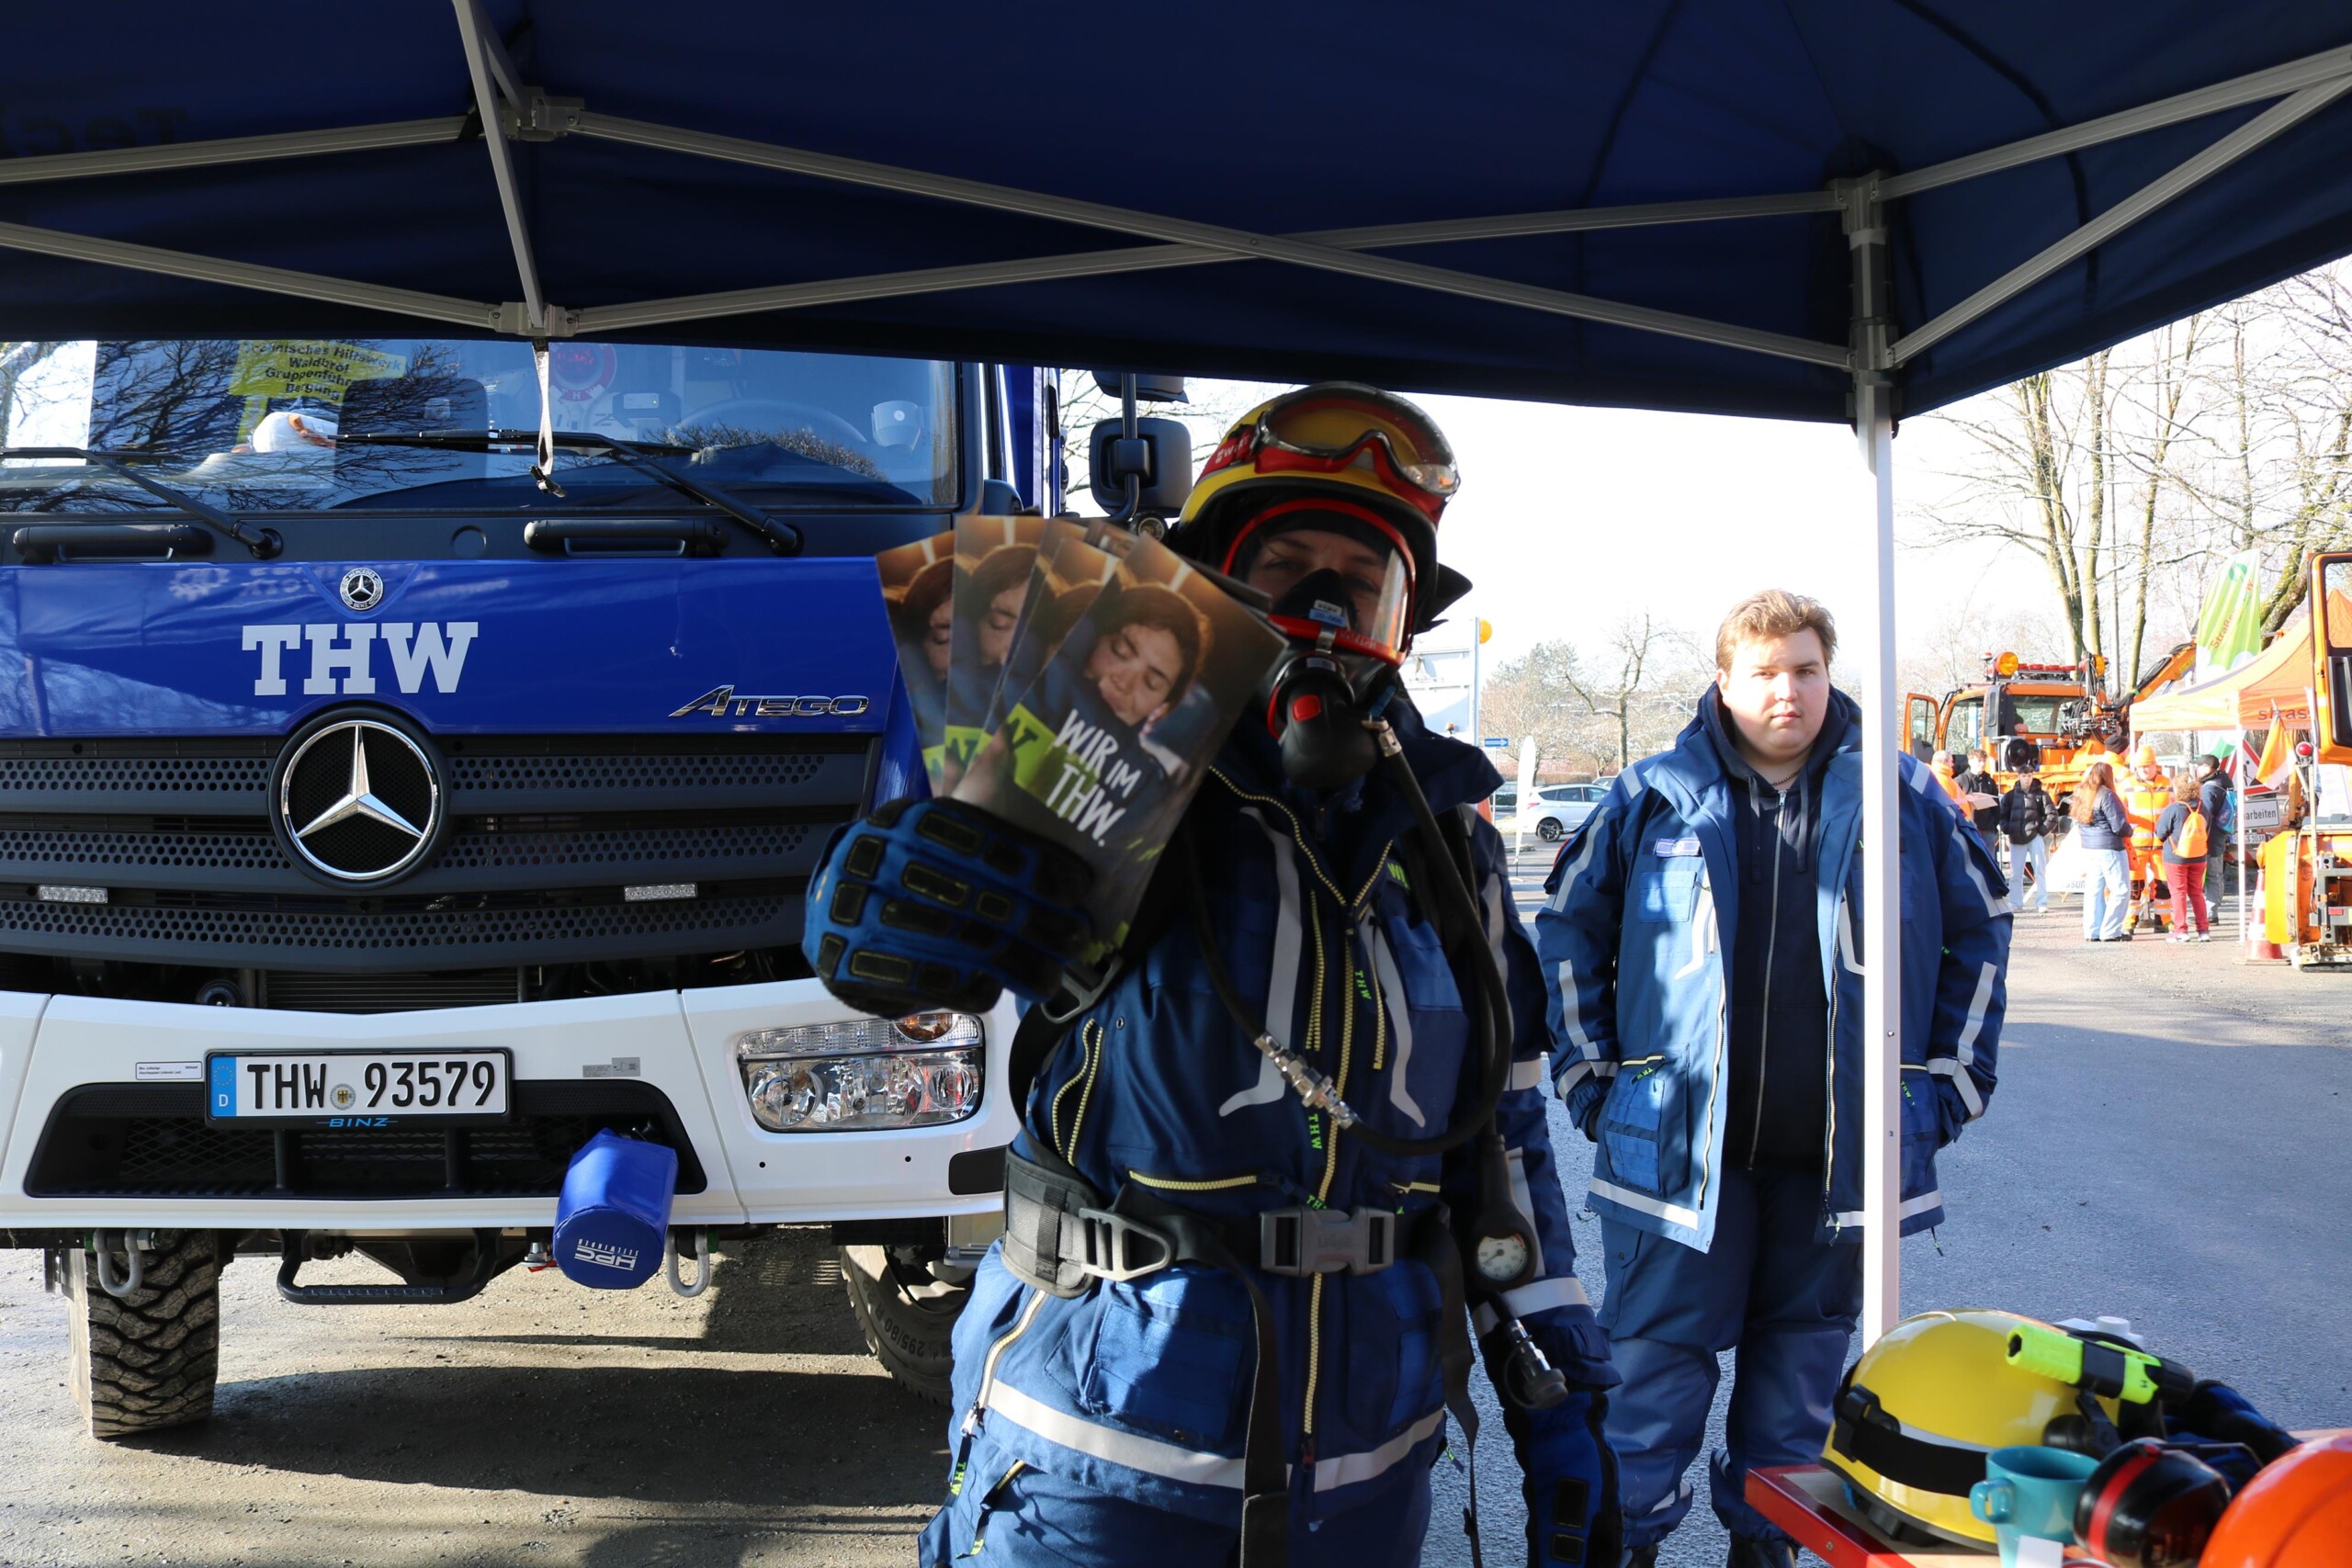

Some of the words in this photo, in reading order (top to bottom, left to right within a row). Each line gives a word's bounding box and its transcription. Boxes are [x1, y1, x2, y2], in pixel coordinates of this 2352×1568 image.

[265, 367, 353, 387] Gruppenführ
[286, 382, 341, 401] Bergung
[242, 621, 479, 695] THW
[668, 684, 869, 717] ATEGO
[1054, 708, 1119, 780] WIR
[1105, 759, 1142, 799] IM
[1046, 762, 1126, 848] THW.
[2244, 807, 2277, 821] arbeiten
[1354, 970, 1372, 1000] THW
[219, 1094, 229, 1107] D
[247, 1063, 326, 1110] THW
[364, 1061, 495, 1108] 93579
[329, 1117, 390, 1127] BINZ
[1308, 1113, 1322, 1150] THW
[1306, 1194, 1328, 1211] TH
[574, 1247, 637, 1269] HPC
[884, 1317, 926, 1358] 295/80
